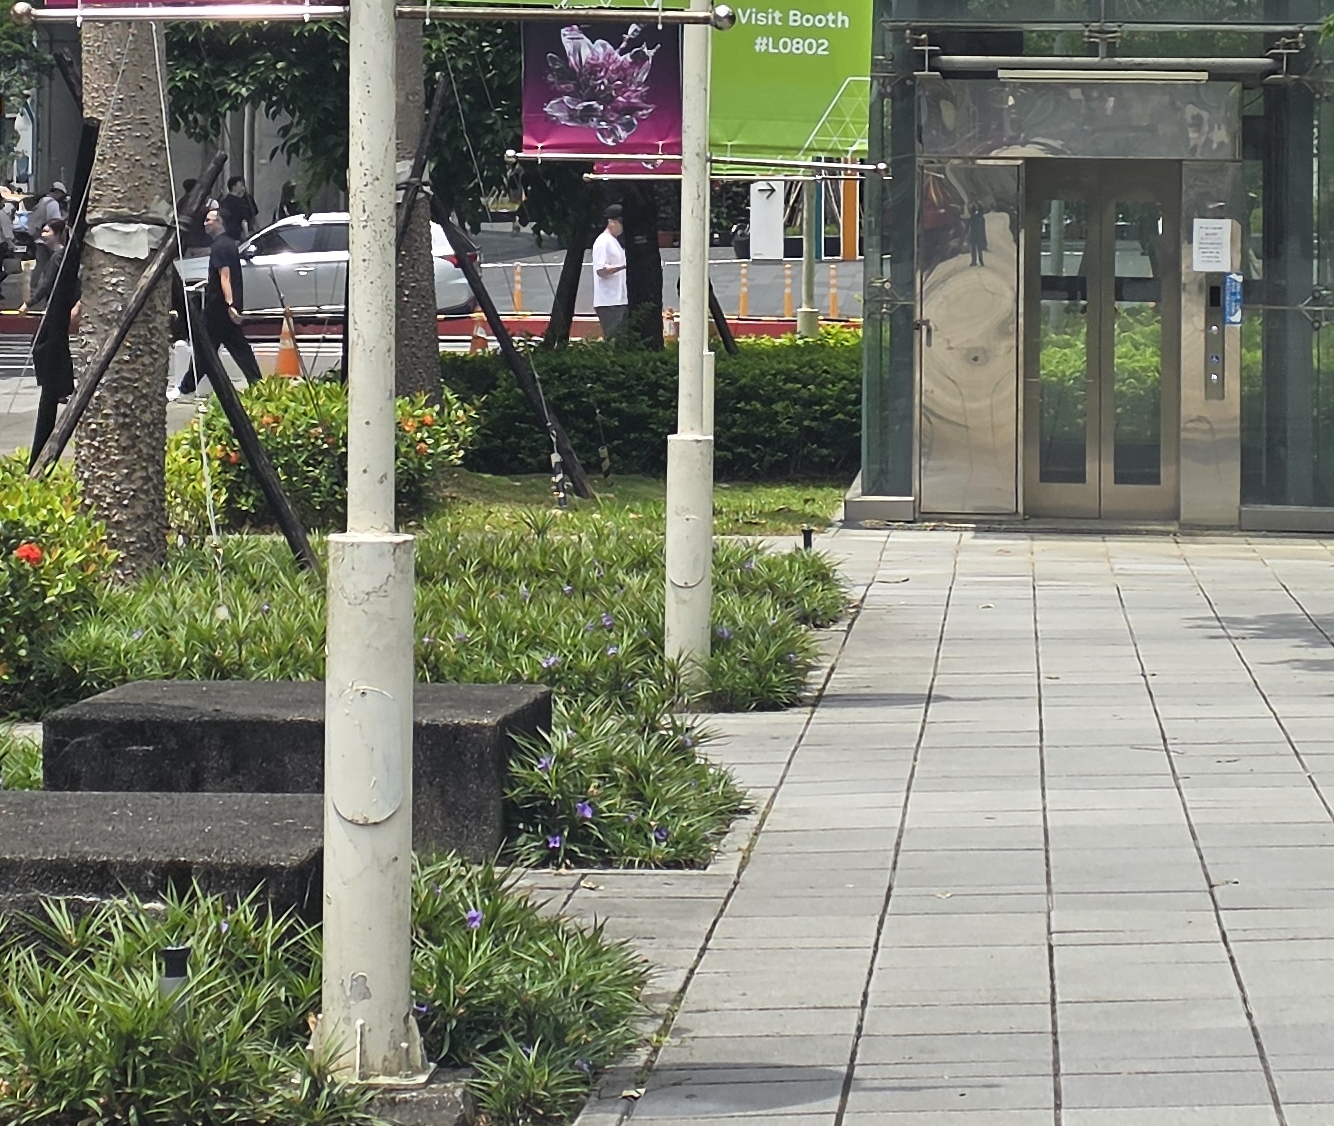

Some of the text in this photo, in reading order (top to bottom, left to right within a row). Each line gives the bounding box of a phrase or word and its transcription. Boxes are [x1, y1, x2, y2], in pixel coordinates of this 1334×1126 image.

[737, 7, 850, 28] Visit Booth
[754, 36, 830, 56] #L0802
